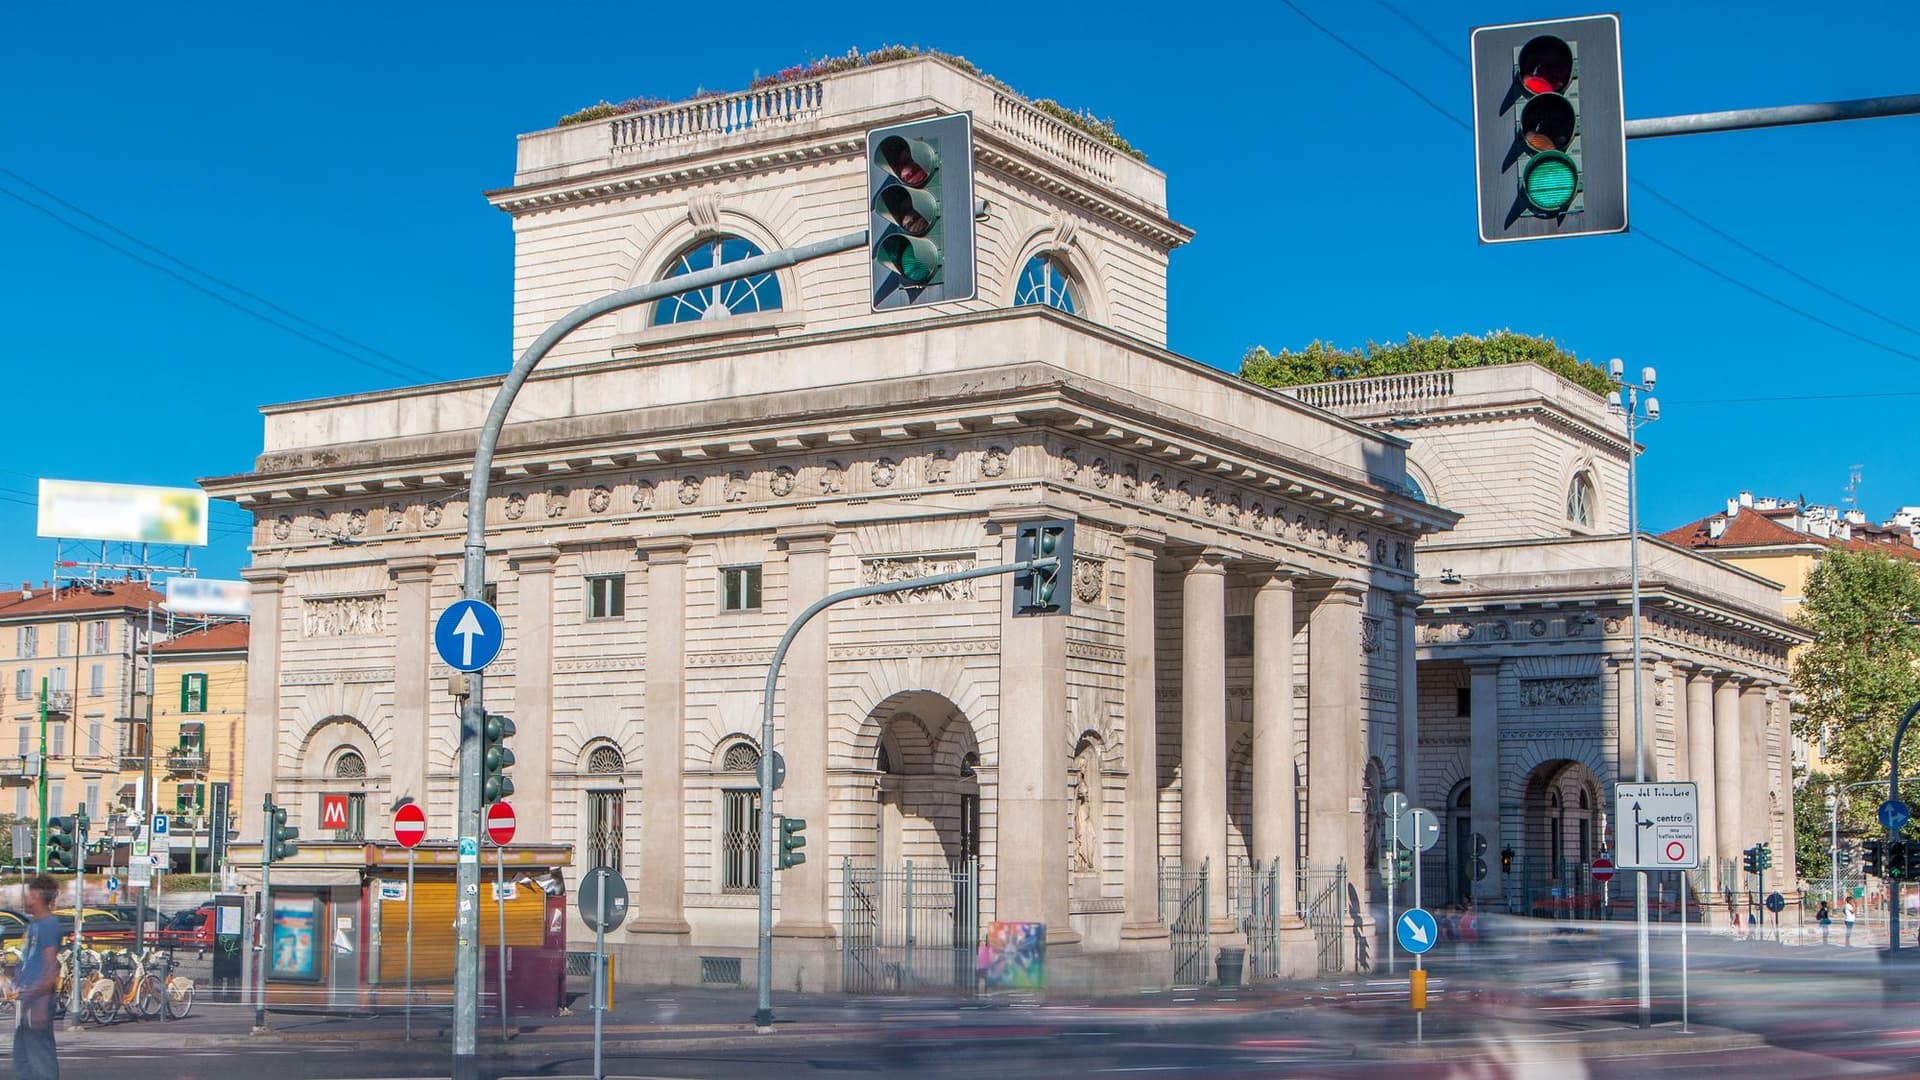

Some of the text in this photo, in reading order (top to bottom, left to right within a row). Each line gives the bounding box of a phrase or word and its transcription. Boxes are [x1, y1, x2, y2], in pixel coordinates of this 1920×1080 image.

[324, 802, 345, 822] M
[1656, 815, 1682, 823] centro
[156, 818, 165, 832] P
